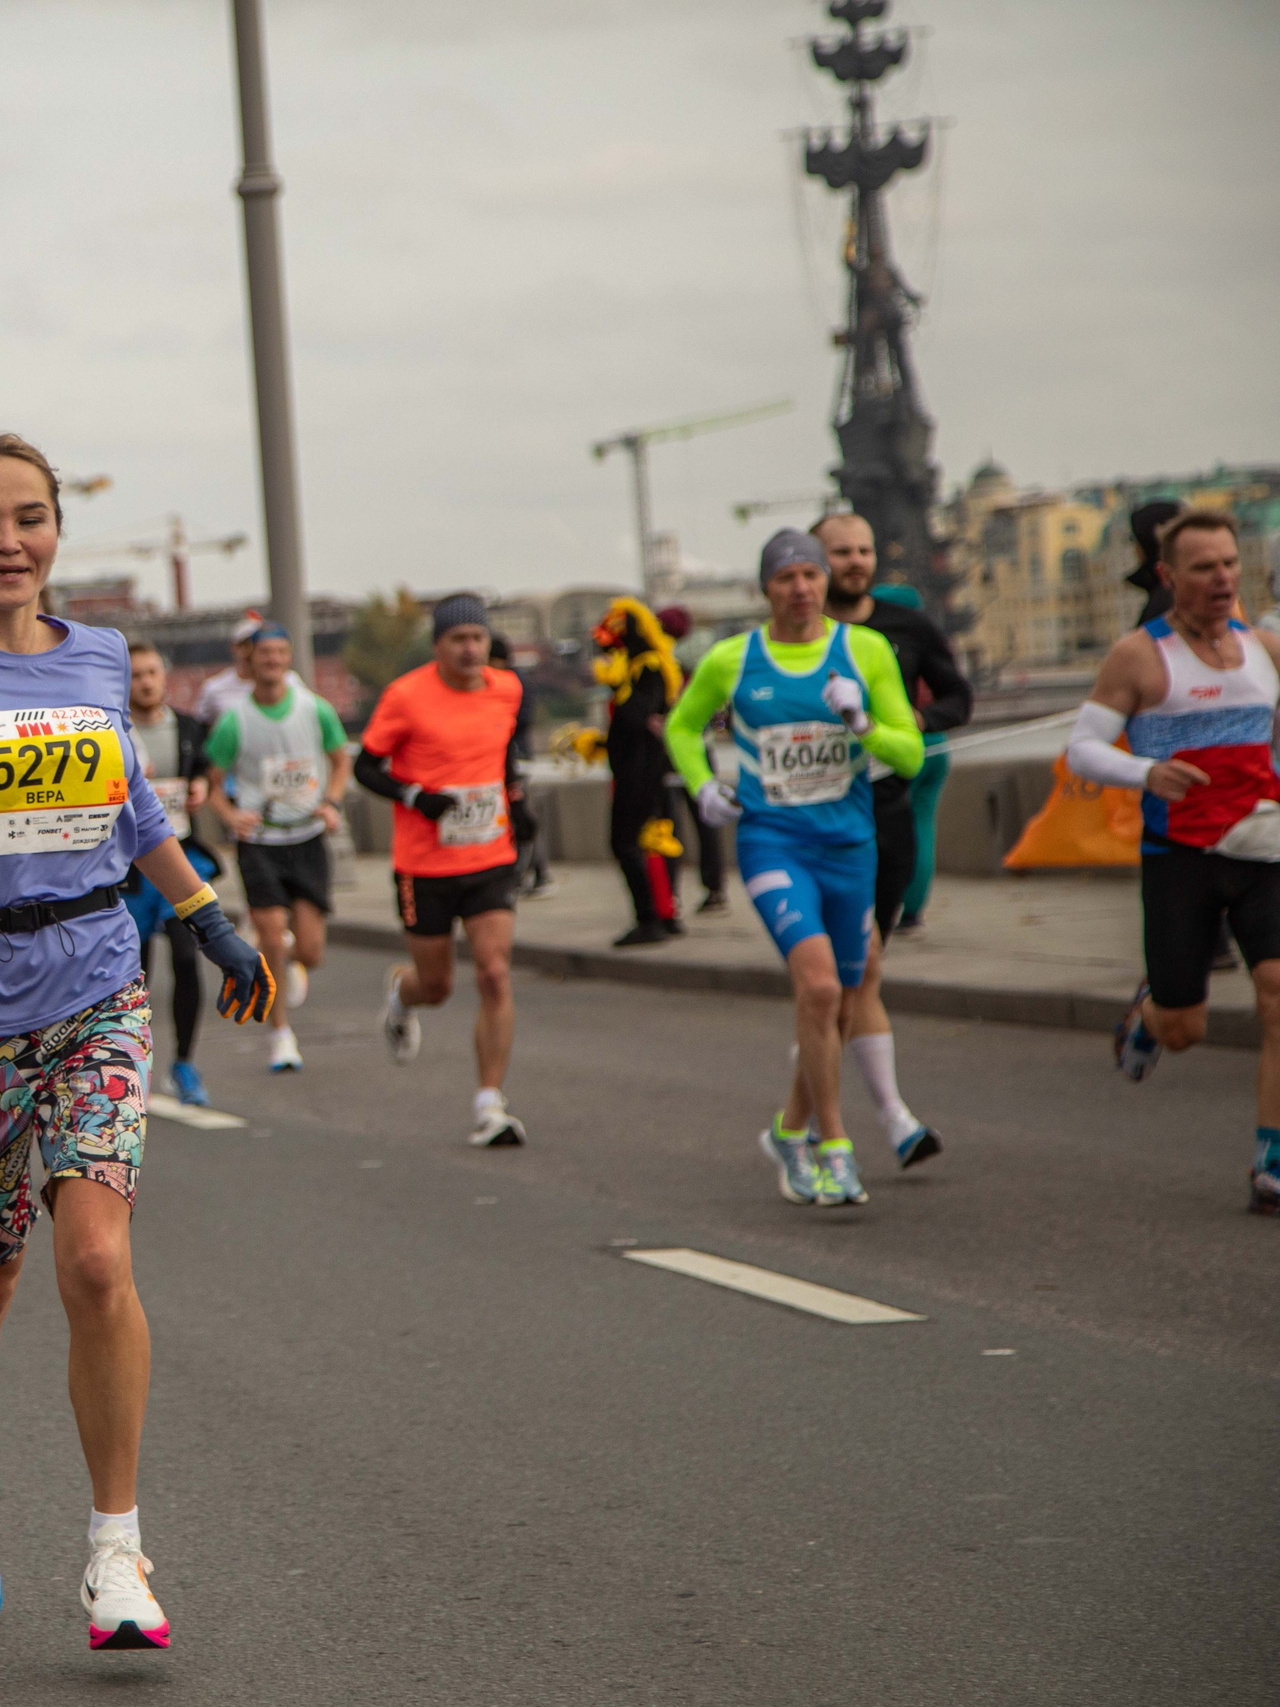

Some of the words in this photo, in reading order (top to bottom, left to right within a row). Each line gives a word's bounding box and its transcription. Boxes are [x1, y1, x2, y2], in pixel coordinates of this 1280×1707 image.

[766, 741, 847, 771] 16040
[26, 790, 65, 804] ВЕРА
[42, 1015, 79, 1053] BOOM
